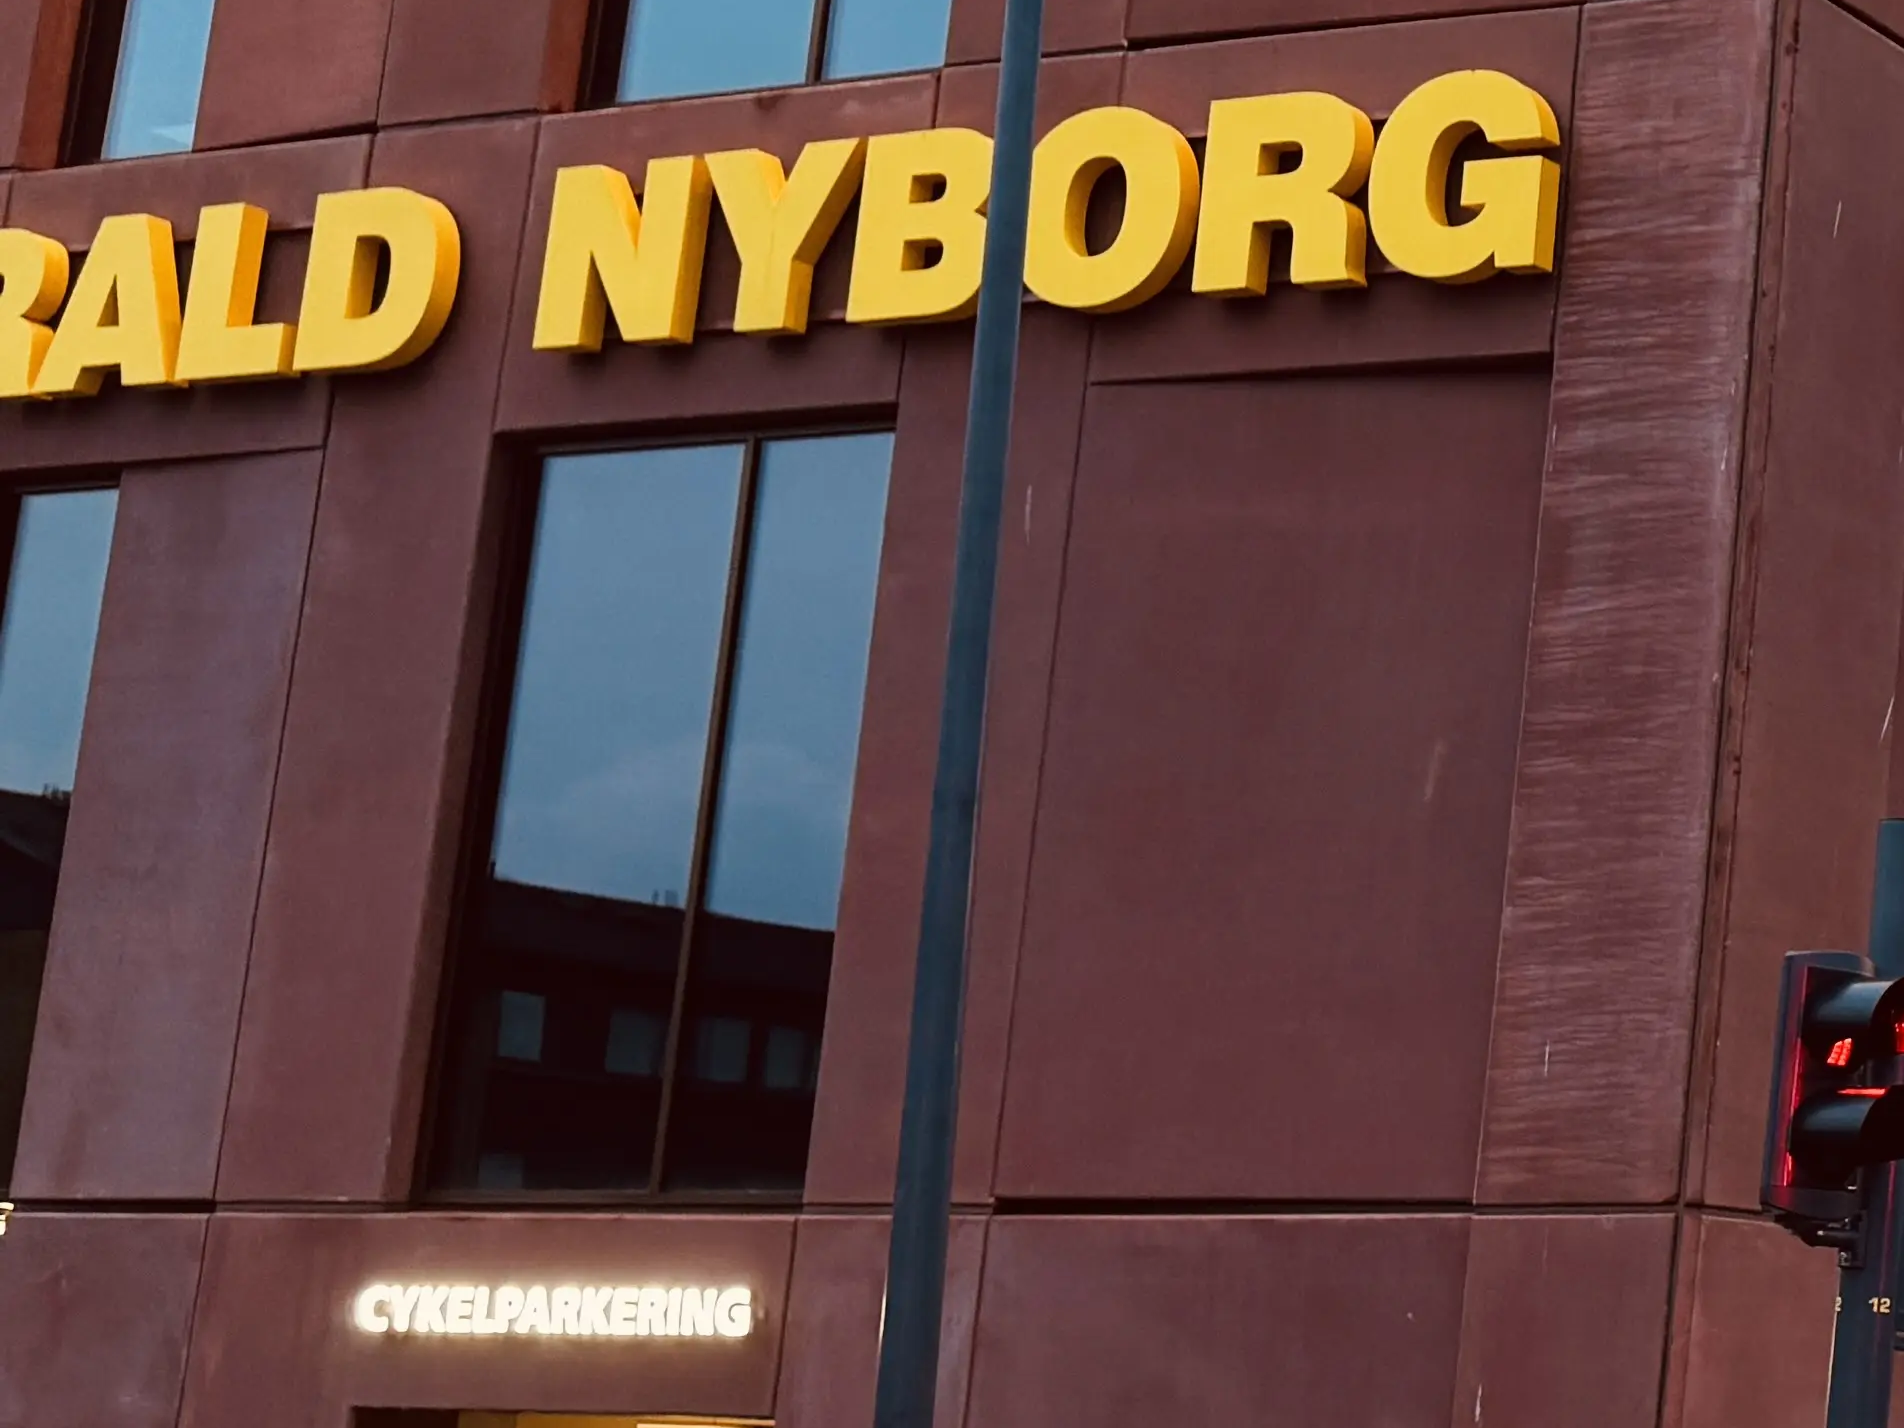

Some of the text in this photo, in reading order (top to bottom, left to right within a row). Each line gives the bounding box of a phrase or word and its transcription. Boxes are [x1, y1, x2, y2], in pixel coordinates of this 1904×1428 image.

[532, 69, 1560, 354] NYBORG
[355, 1284, 753, 1337] CYKELPARKERING
[1868, 1297, 1891, 1313] 12
